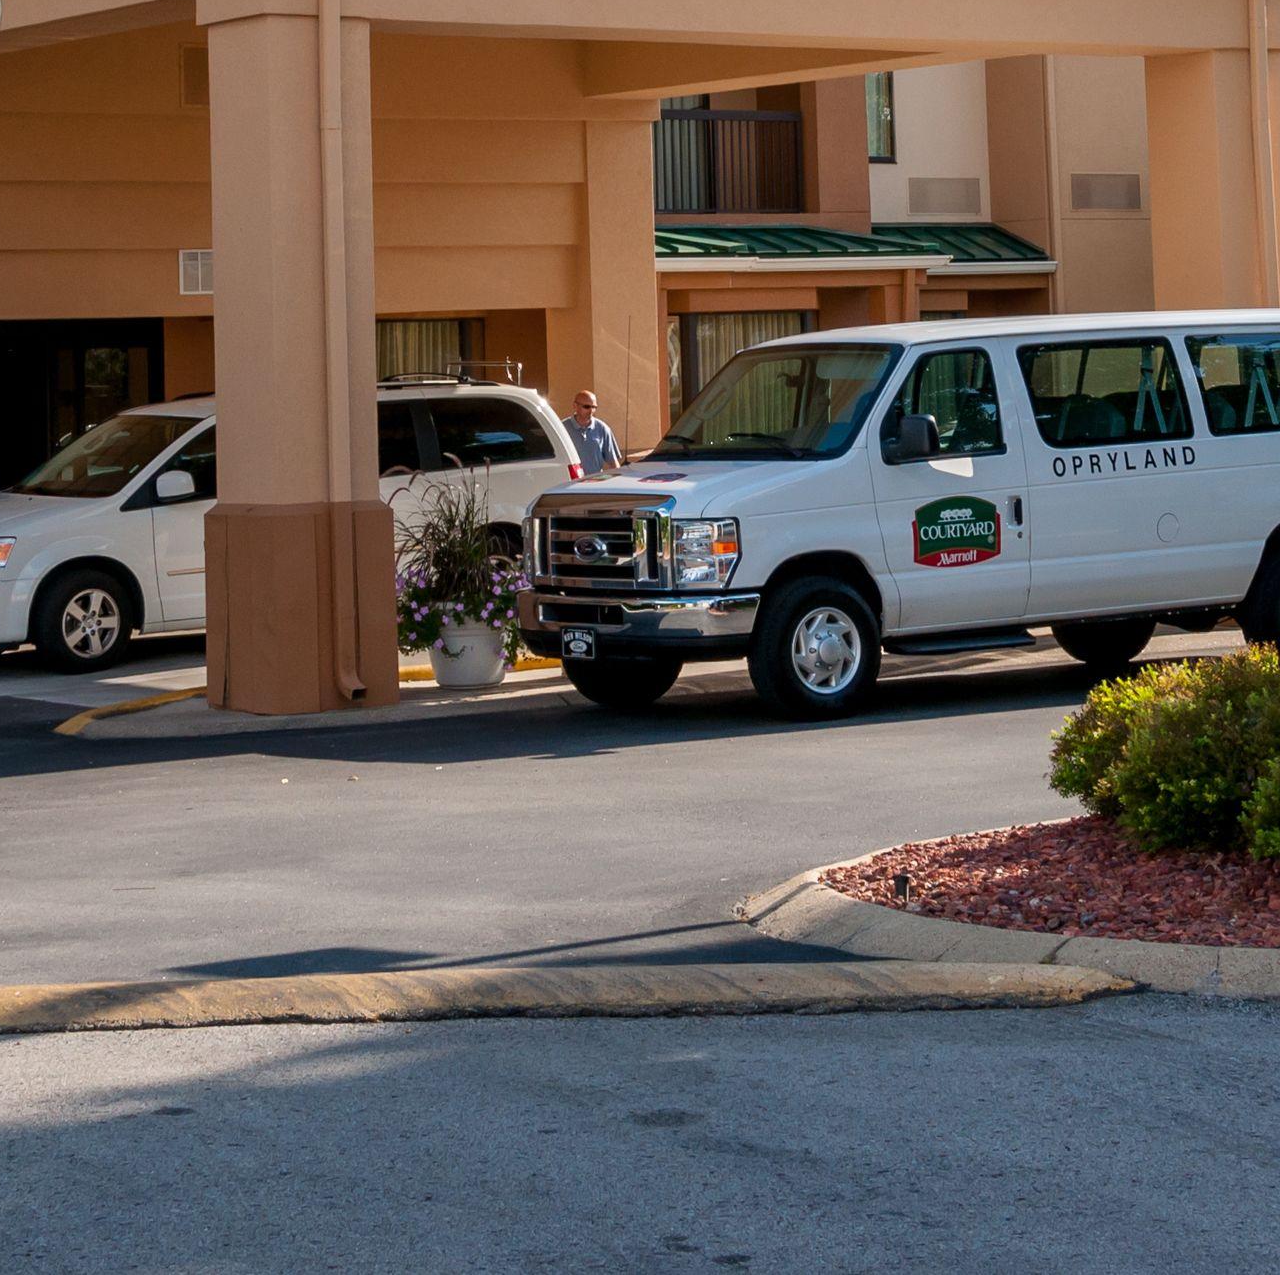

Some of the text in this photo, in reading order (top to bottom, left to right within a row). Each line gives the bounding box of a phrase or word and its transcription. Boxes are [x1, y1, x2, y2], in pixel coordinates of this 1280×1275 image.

[1052, 446, 1196, 477] OPRYLAND
[920, 521, 995, 541] COURTYARD
[937, 550, 977, 567] Marriott
